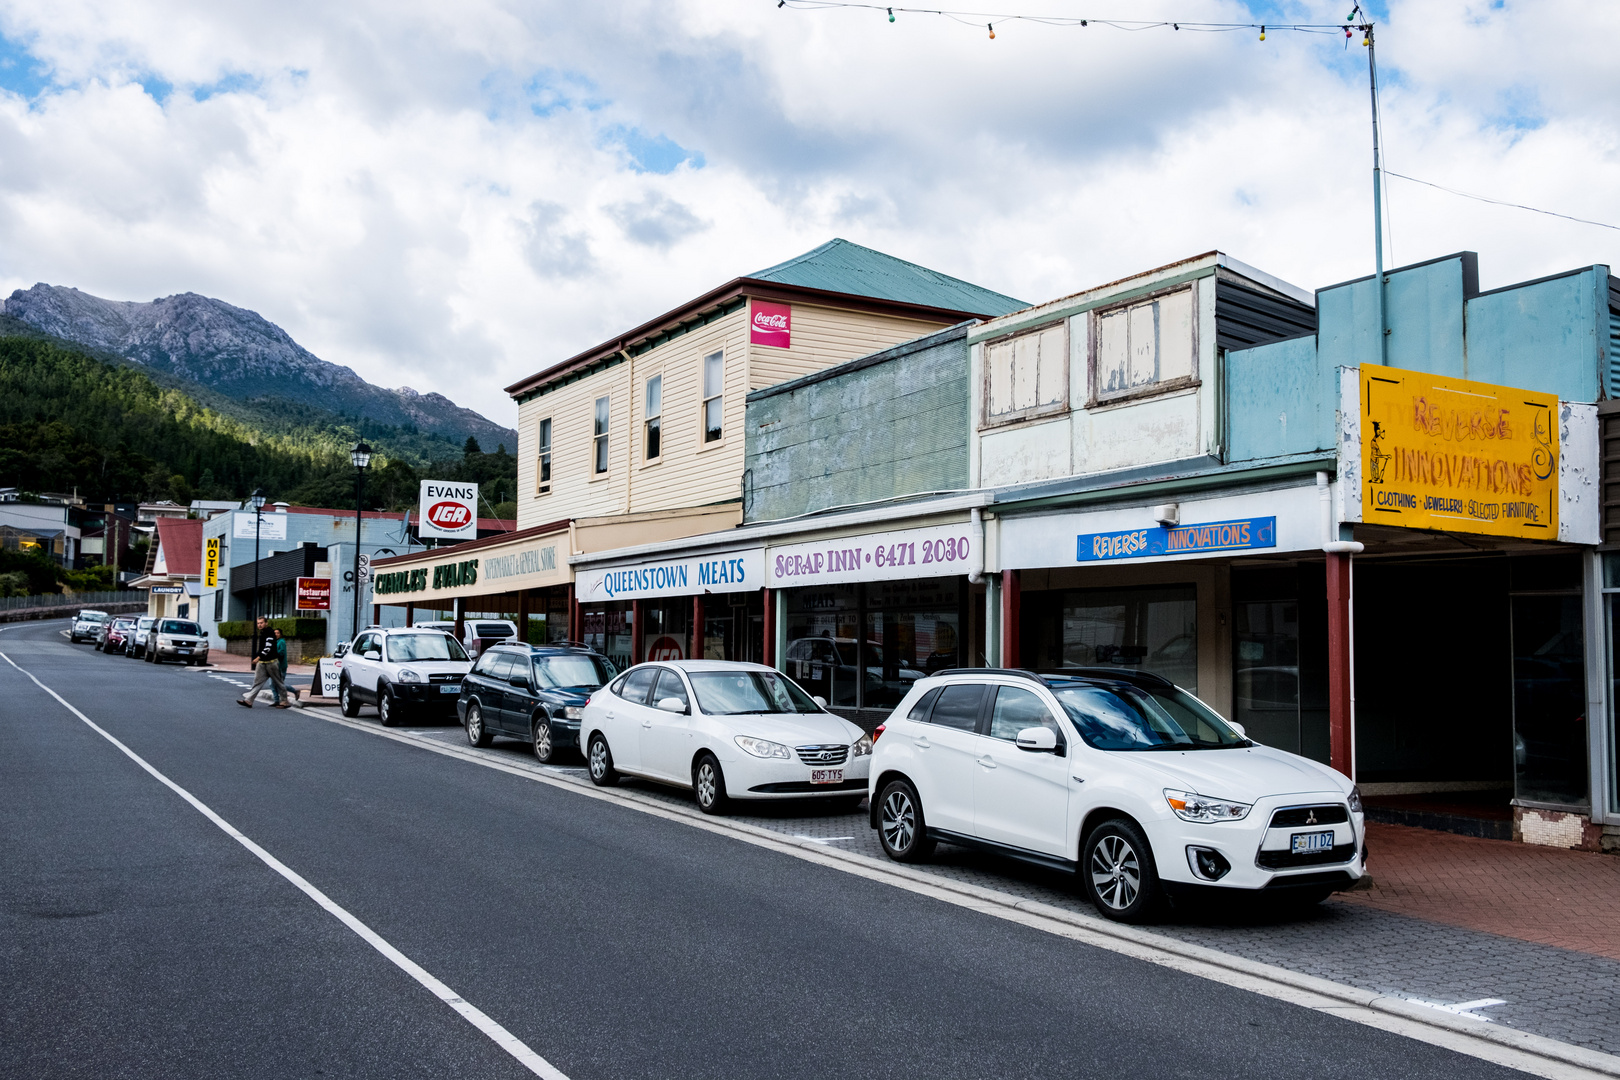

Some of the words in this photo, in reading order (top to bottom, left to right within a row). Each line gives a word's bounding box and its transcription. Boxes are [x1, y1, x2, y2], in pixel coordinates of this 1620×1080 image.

[754, 312, 787, 328] Coca-Cola
[1413, 396, 1512, 442] REVERSE
[1394, 446, 1532, 497] INNOVATIONS
[427, 486, 473, 500] EVANS
[1377, 491, 1417, 509] CLOTHING
[1424, 495, 1462, 514] JEWELLERY
[1468, 499, 1499, 520] SELECTED
[1502, 502, 1540, 522] FURNITURE
[432, 505, 468, 523] IGA
[775, 553, 824, 578] SCRAP
[827, 548, 862, 572] INN
[875, 542, 916, 567] 6471
[922, 536, 970, 564] 2030
[1093, 530, 1148, 558] REVERSE
[1168, 524, 1251, 549] INNOVATIONS
[207, 539, 218, 586] MOTEL
[375, 568, 428, 595] CHARLES
[432, 559, 479, 589] EVANS
[484, 554, 516, 580] SUPERMARKET
[520, 549, 540, 574] GENERAL
[541, 546, 556, 571] STORE
[604, 564, 688, 597] QUEENSTOWN
[698, 558, 745, 586] MEATS
[299, 588, 330, 597] Restaurant
[803, 593, 835, 609] MEATS
